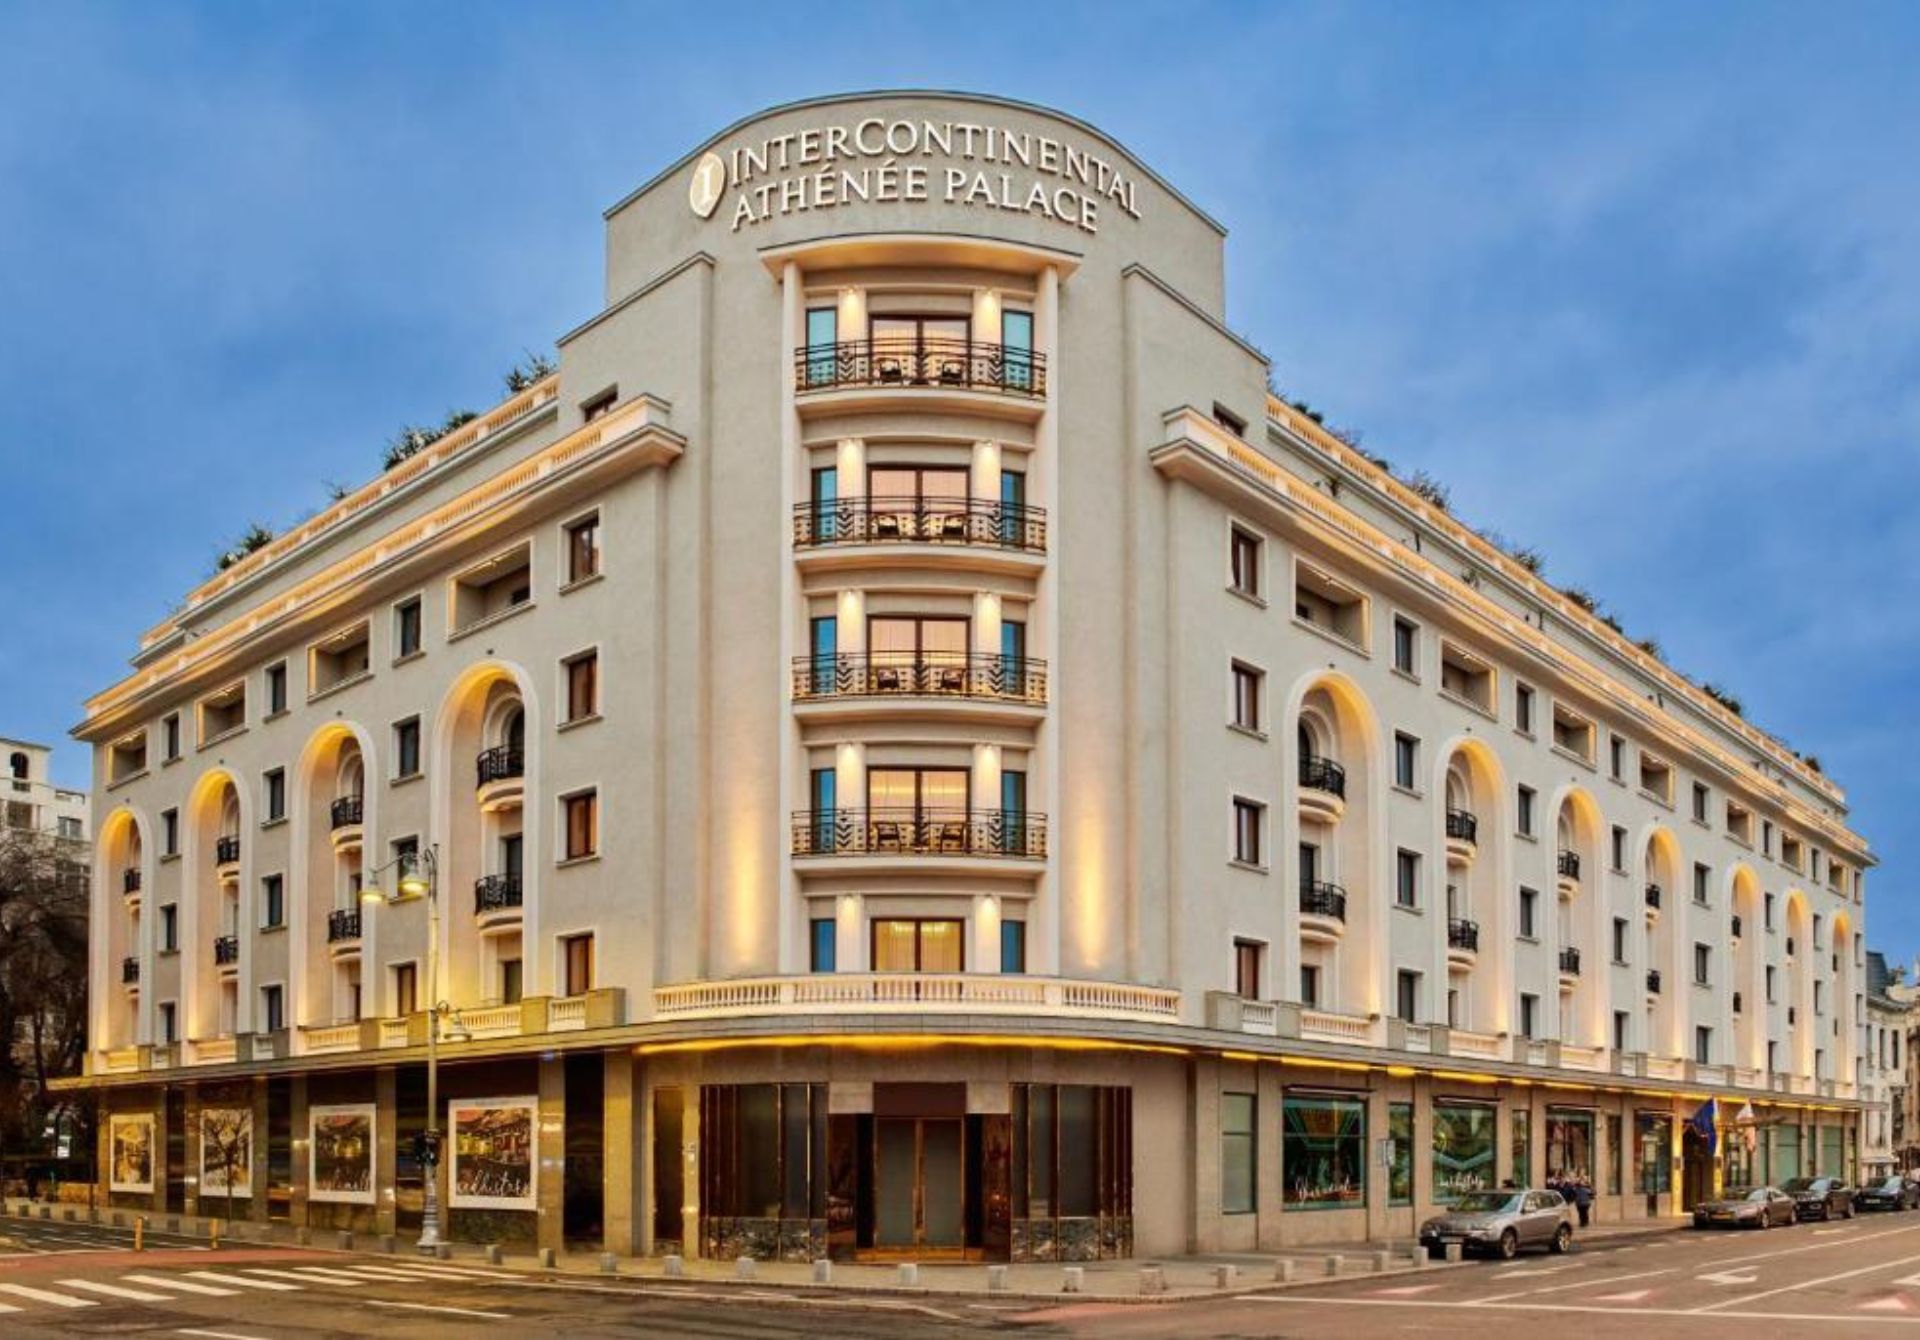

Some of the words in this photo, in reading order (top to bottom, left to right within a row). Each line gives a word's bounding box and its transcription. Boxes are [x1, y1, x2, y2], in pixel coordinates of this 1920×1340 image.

[731, 117, 1142, 219] INTERCONTINENTAL
[731, 158, 929, 233] ATHÉNÉE
[943, 167, 1099, 233] PALACE
